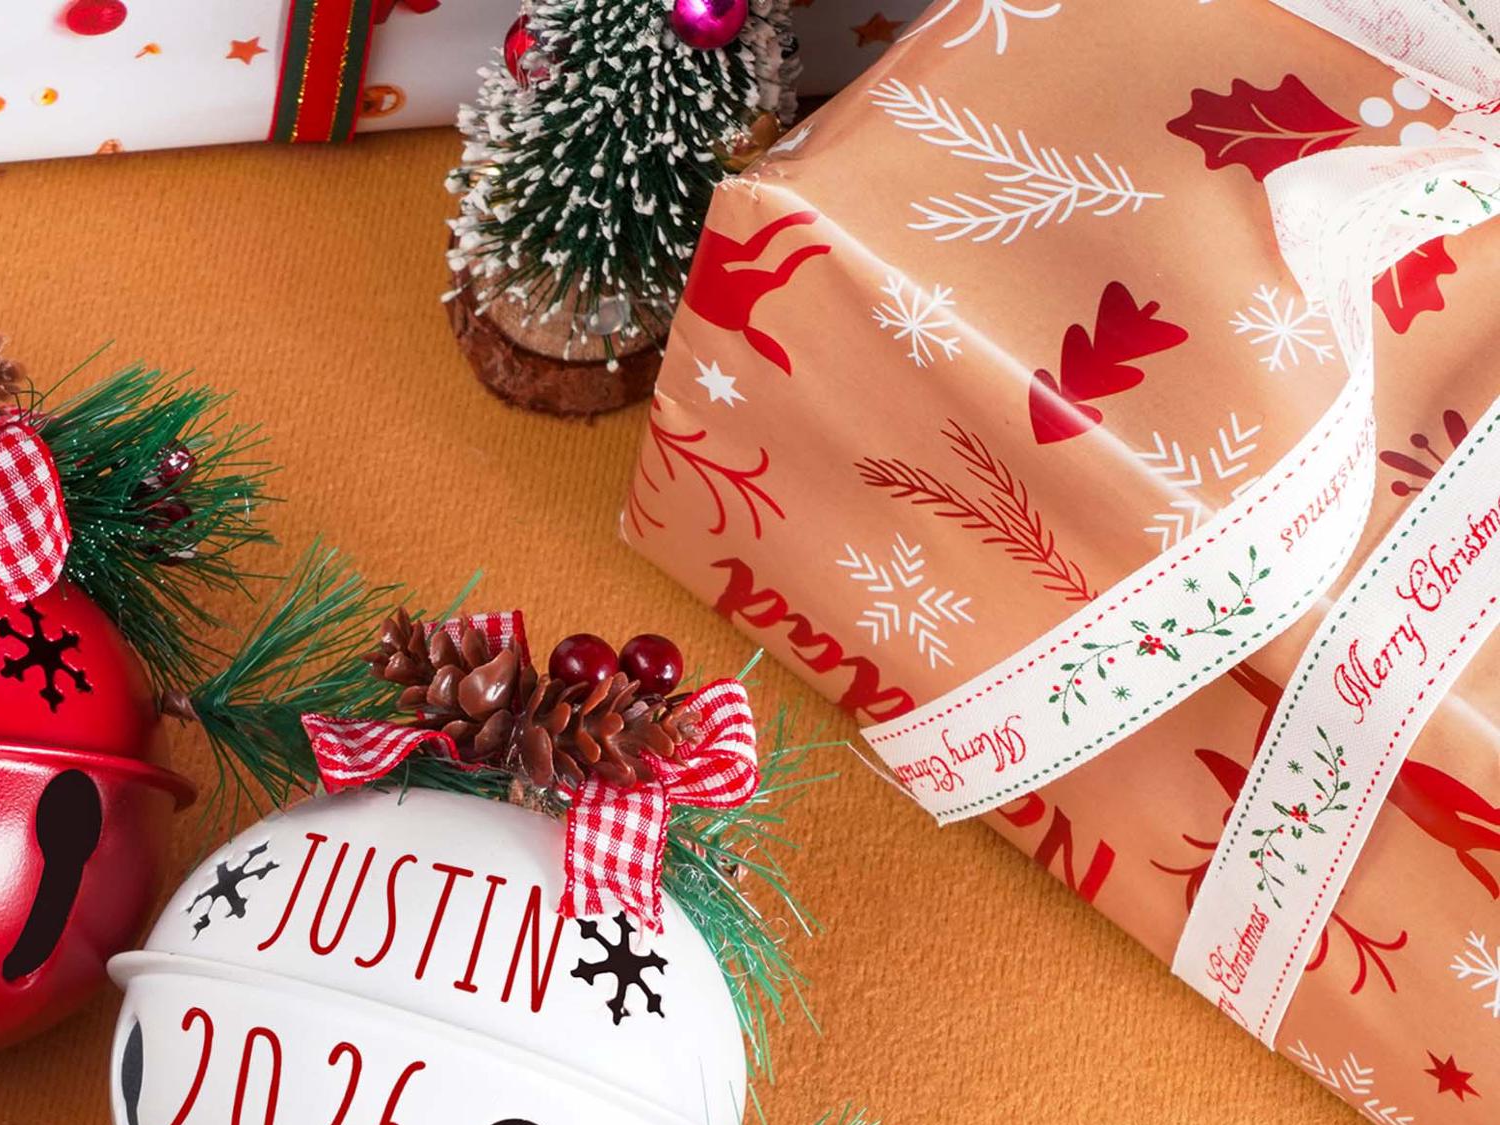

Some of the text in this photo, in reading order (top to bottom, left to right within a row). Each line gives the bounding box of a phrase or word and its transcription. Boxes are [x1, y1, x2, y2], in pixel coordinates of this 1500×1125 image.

[1334, 494, 1500, 725] Merry Christm
[941, 714, 1026, 773] Merry
[257, 832, 565, 1013] JUSTIN
[1206, 903, 1270, 995] Christmas
